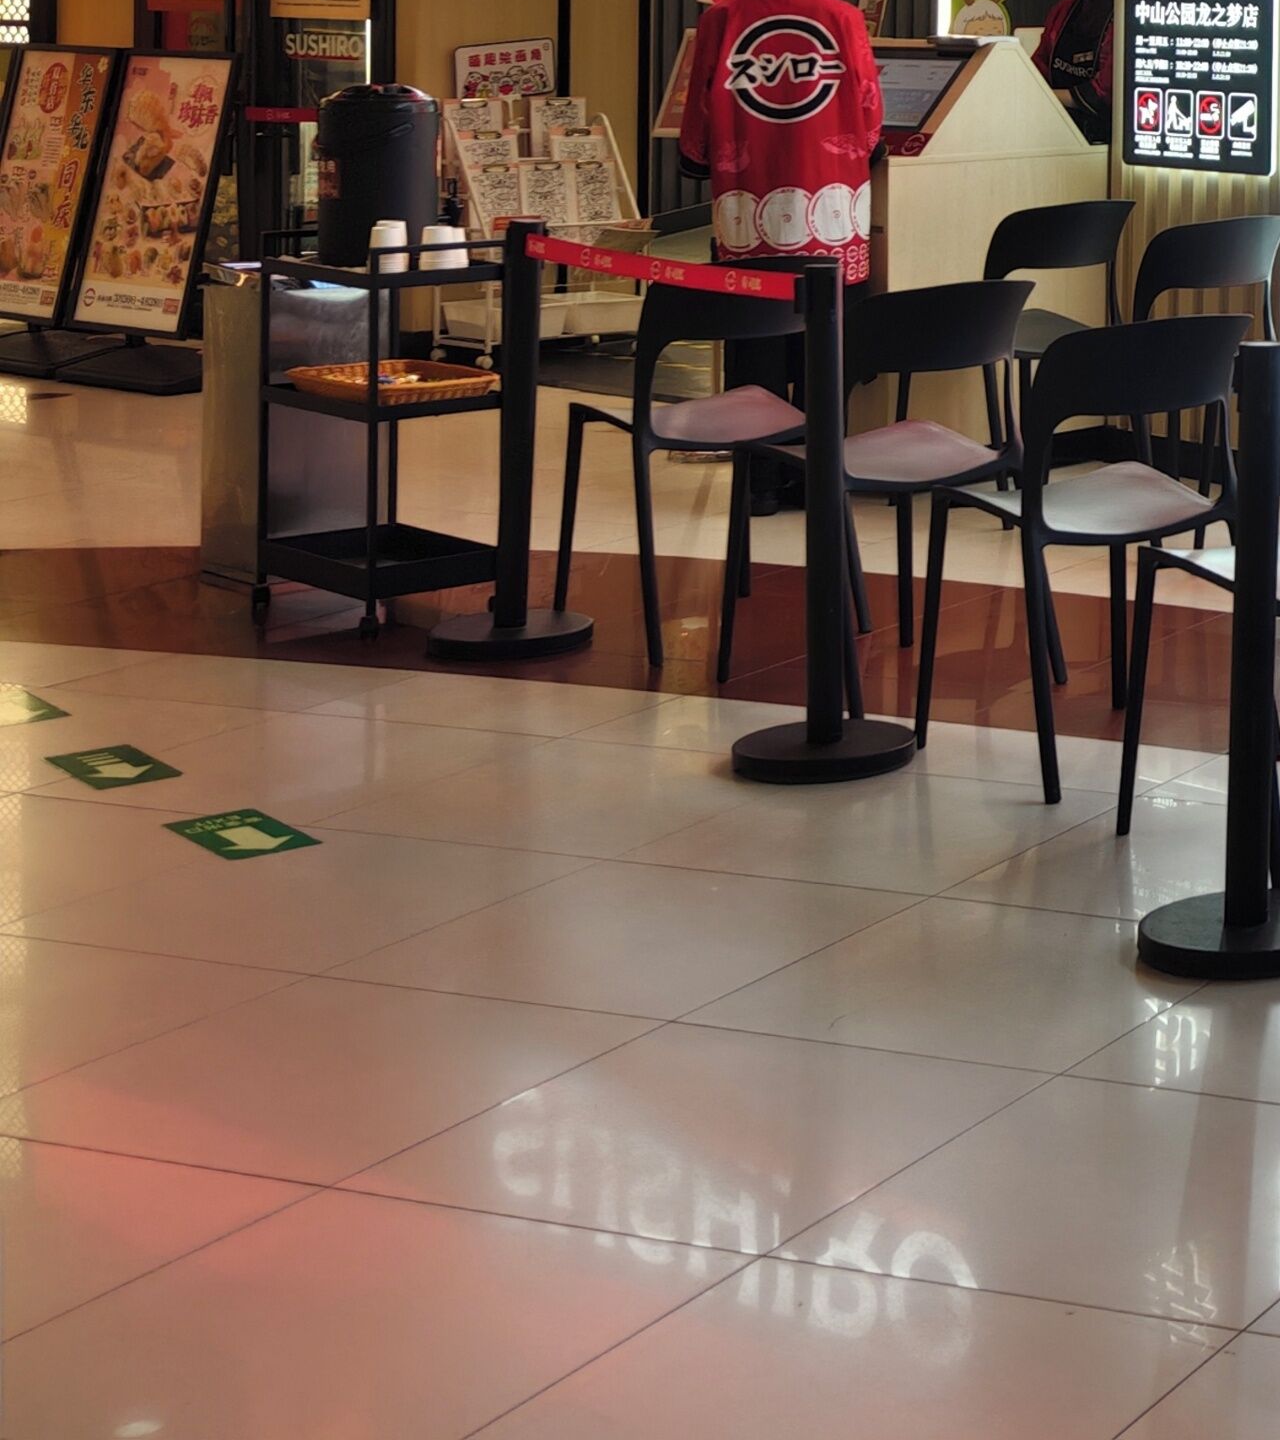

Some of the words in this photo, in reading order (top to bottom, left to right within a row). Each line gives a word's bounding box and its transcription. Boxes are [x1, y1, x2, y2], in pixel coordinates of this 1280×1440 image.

[1134, 0, 1259, 28] 中山公园龙之梦店
[285, 32, 362, 58] SUSHIRO
[726, 52, 846, 88] スシロー
